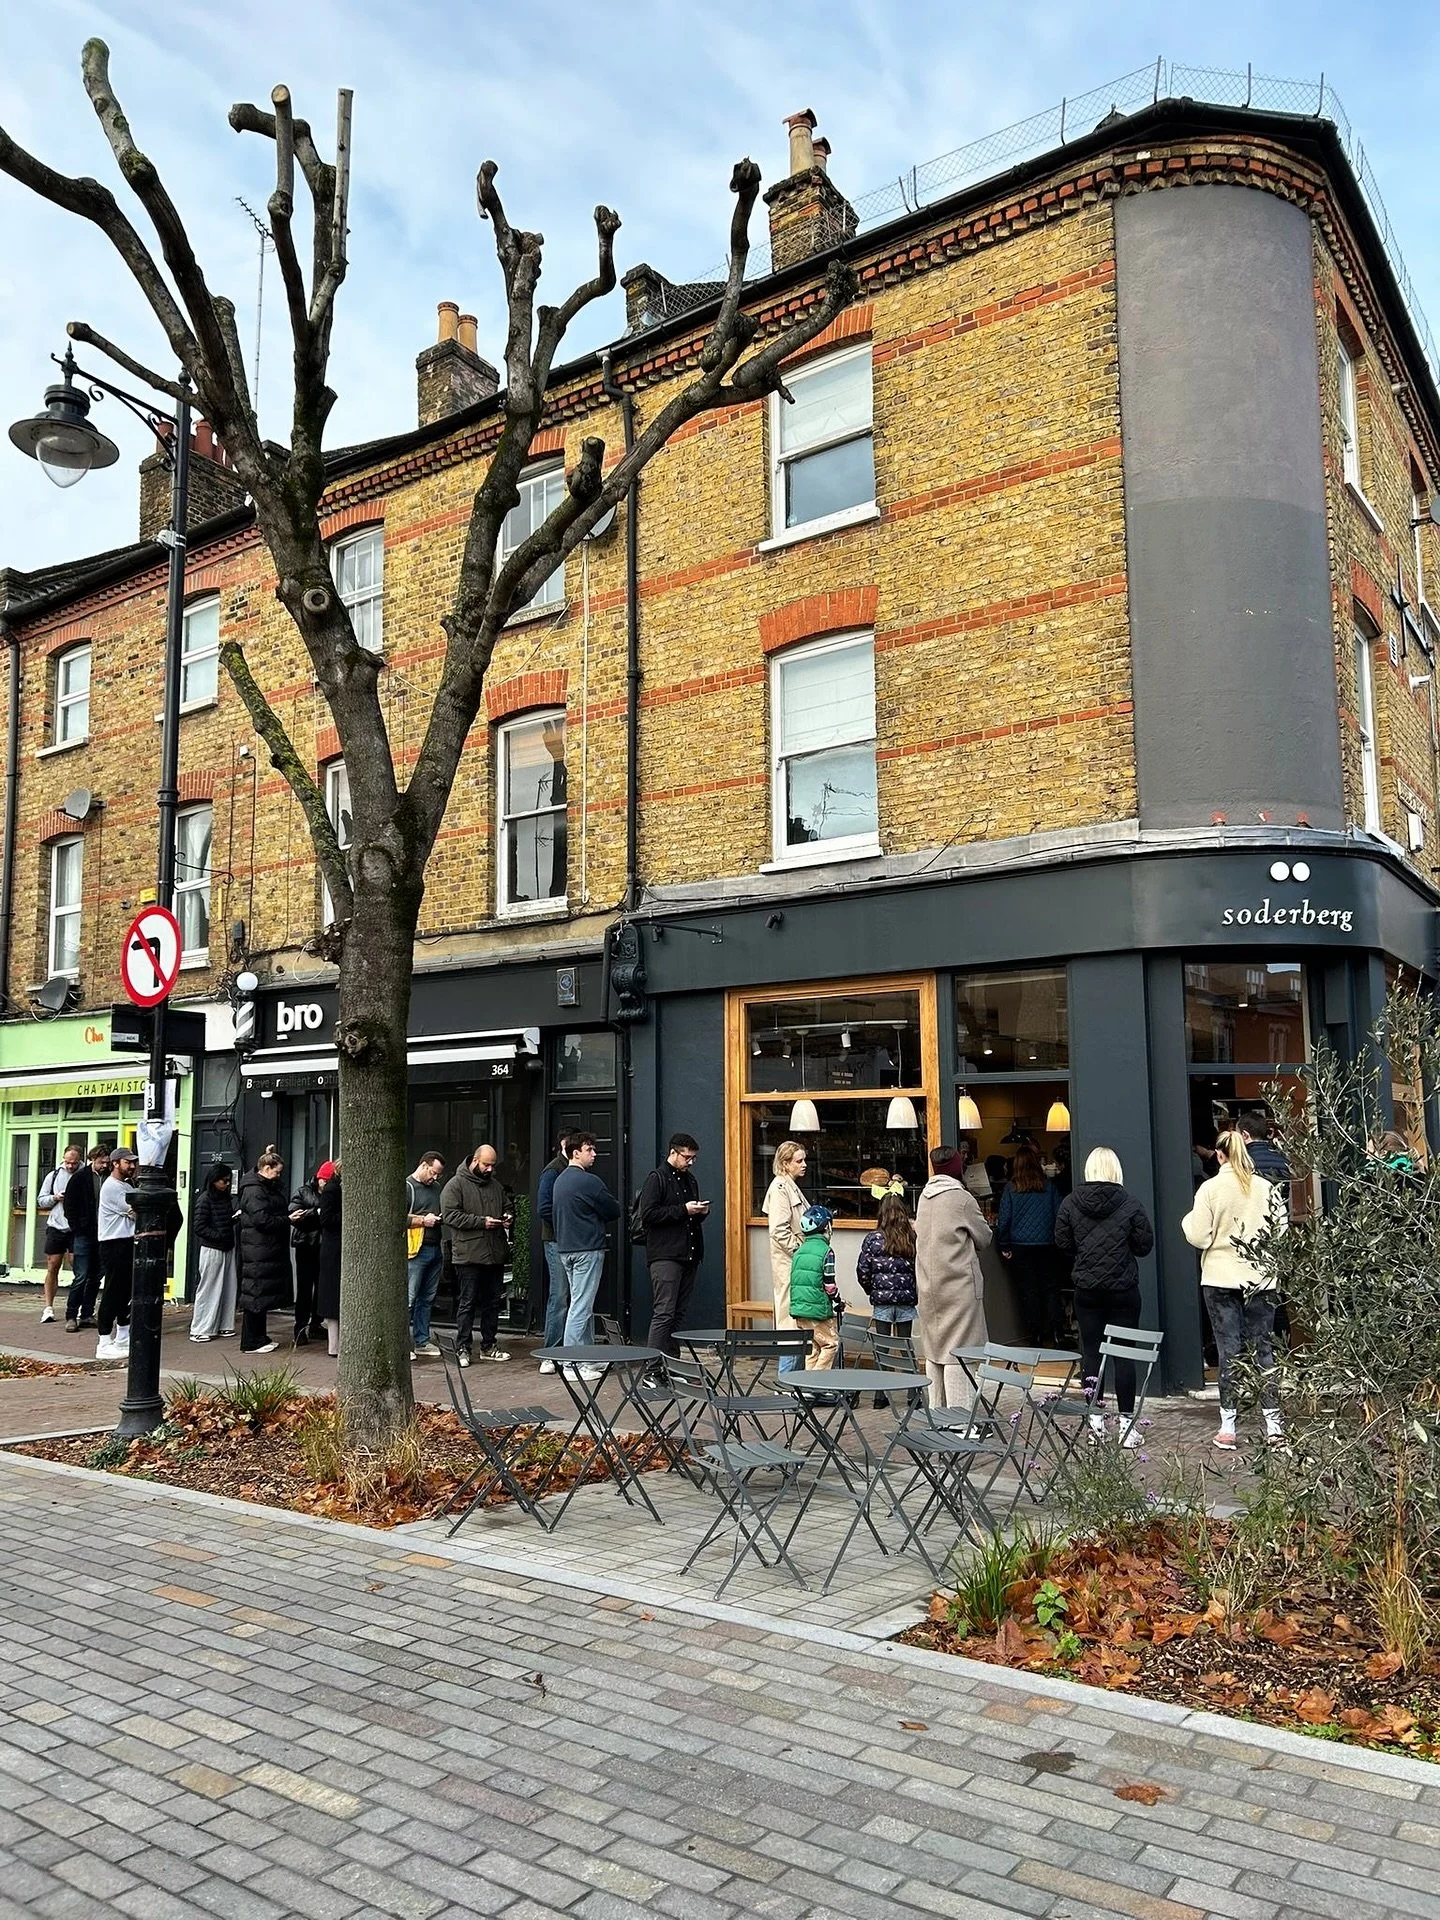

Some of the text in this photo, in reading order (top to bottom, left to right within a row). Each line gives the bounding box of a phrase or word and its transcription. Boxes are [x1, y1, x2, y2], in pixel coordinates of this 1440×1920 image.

[1221, 898, 1353, 932] soderberg
[276, 1001, 324, 1033] bro
[84, 1026, 104, 1044] Cha
[491, 1063, 509, 1076] 364
[77, 1085, 96, 1096] CHA
[100, 1082, 124, 1094] THAI
